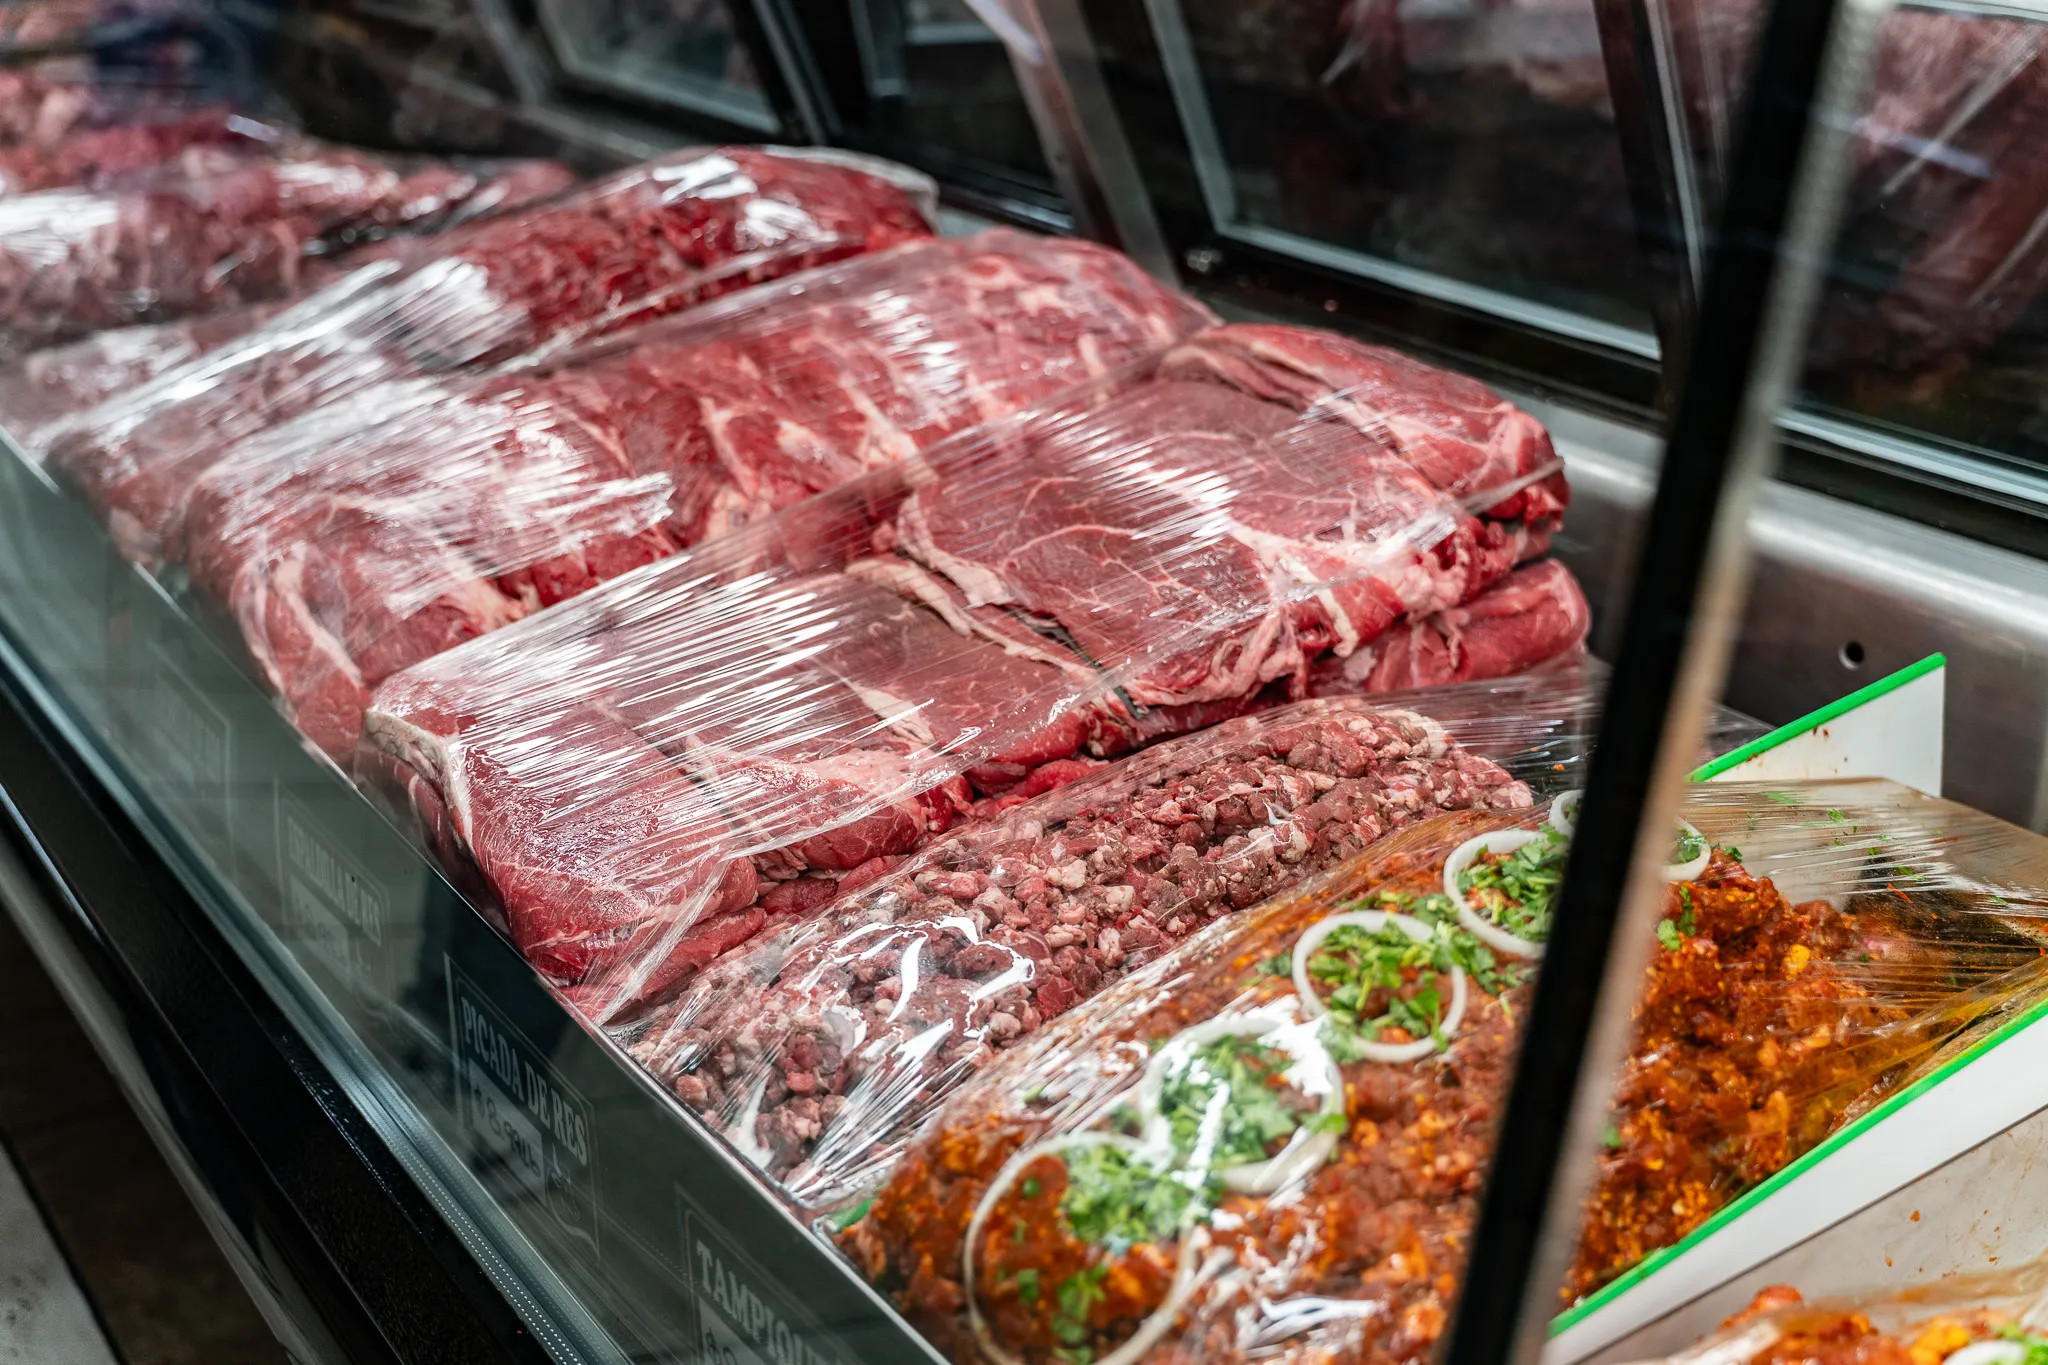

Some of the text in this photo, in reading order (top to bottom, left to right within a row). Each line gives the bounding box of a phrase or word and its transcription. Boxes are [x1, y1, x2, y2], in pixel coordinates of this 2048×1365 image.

[462, 998, 587, 1167] PICADA DE RES
